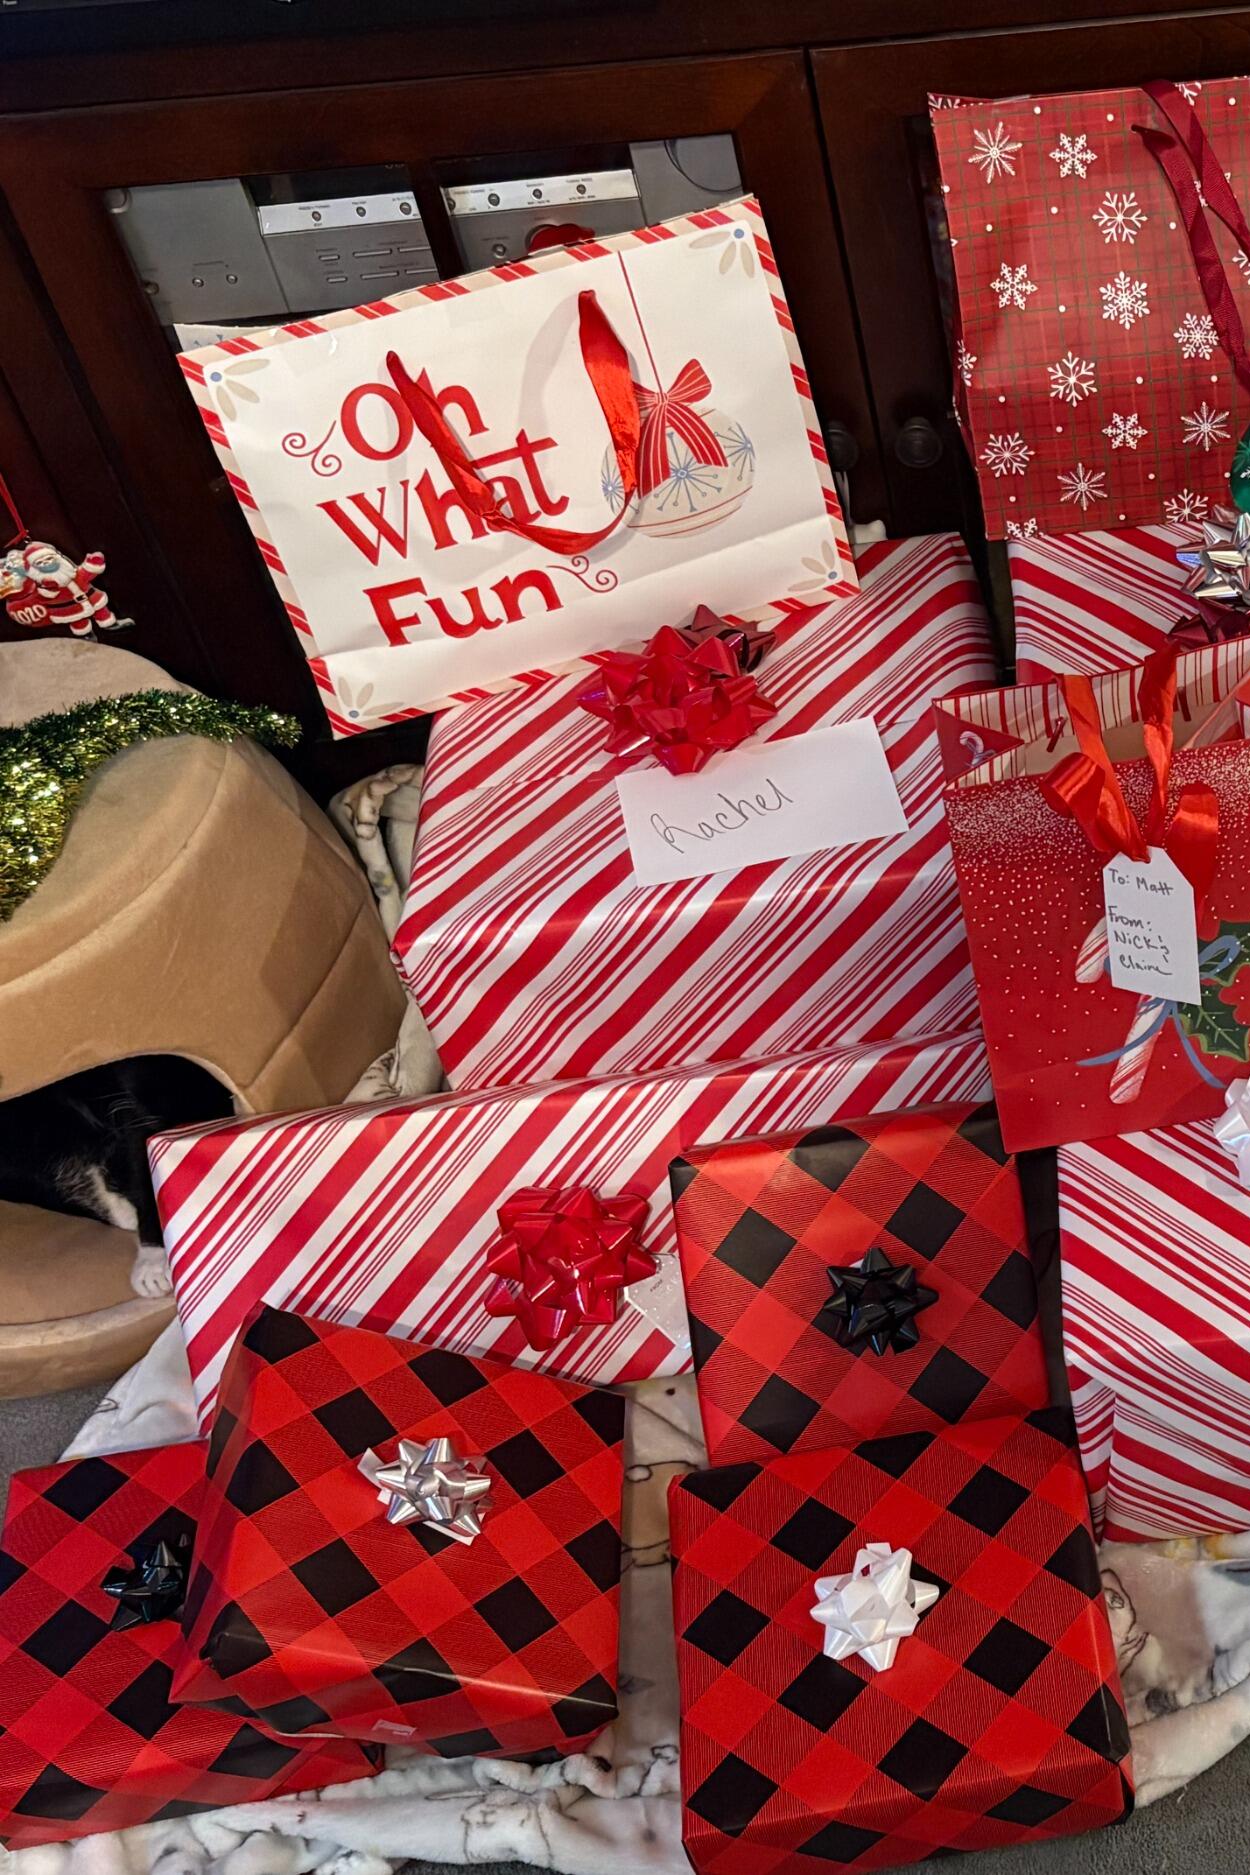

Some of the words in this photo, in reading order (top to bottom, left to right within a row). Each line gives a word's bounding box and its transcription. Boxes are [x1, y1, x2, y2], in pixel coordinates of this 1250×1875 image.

[340, 367, 490, 461] Oh
[316, 428, 570, 567] What
[363, 569, 564, 647] Fun
[650, 778, 794, 854] Rachel
[1108, 868, 1130, 884] To:
[1136, 877, 1174, 895] Matt
[1108, 905, 1152, 931] From:
[1114, 930, 1158, 950] Nick
[1120, 954, 1173, 976] Claire
